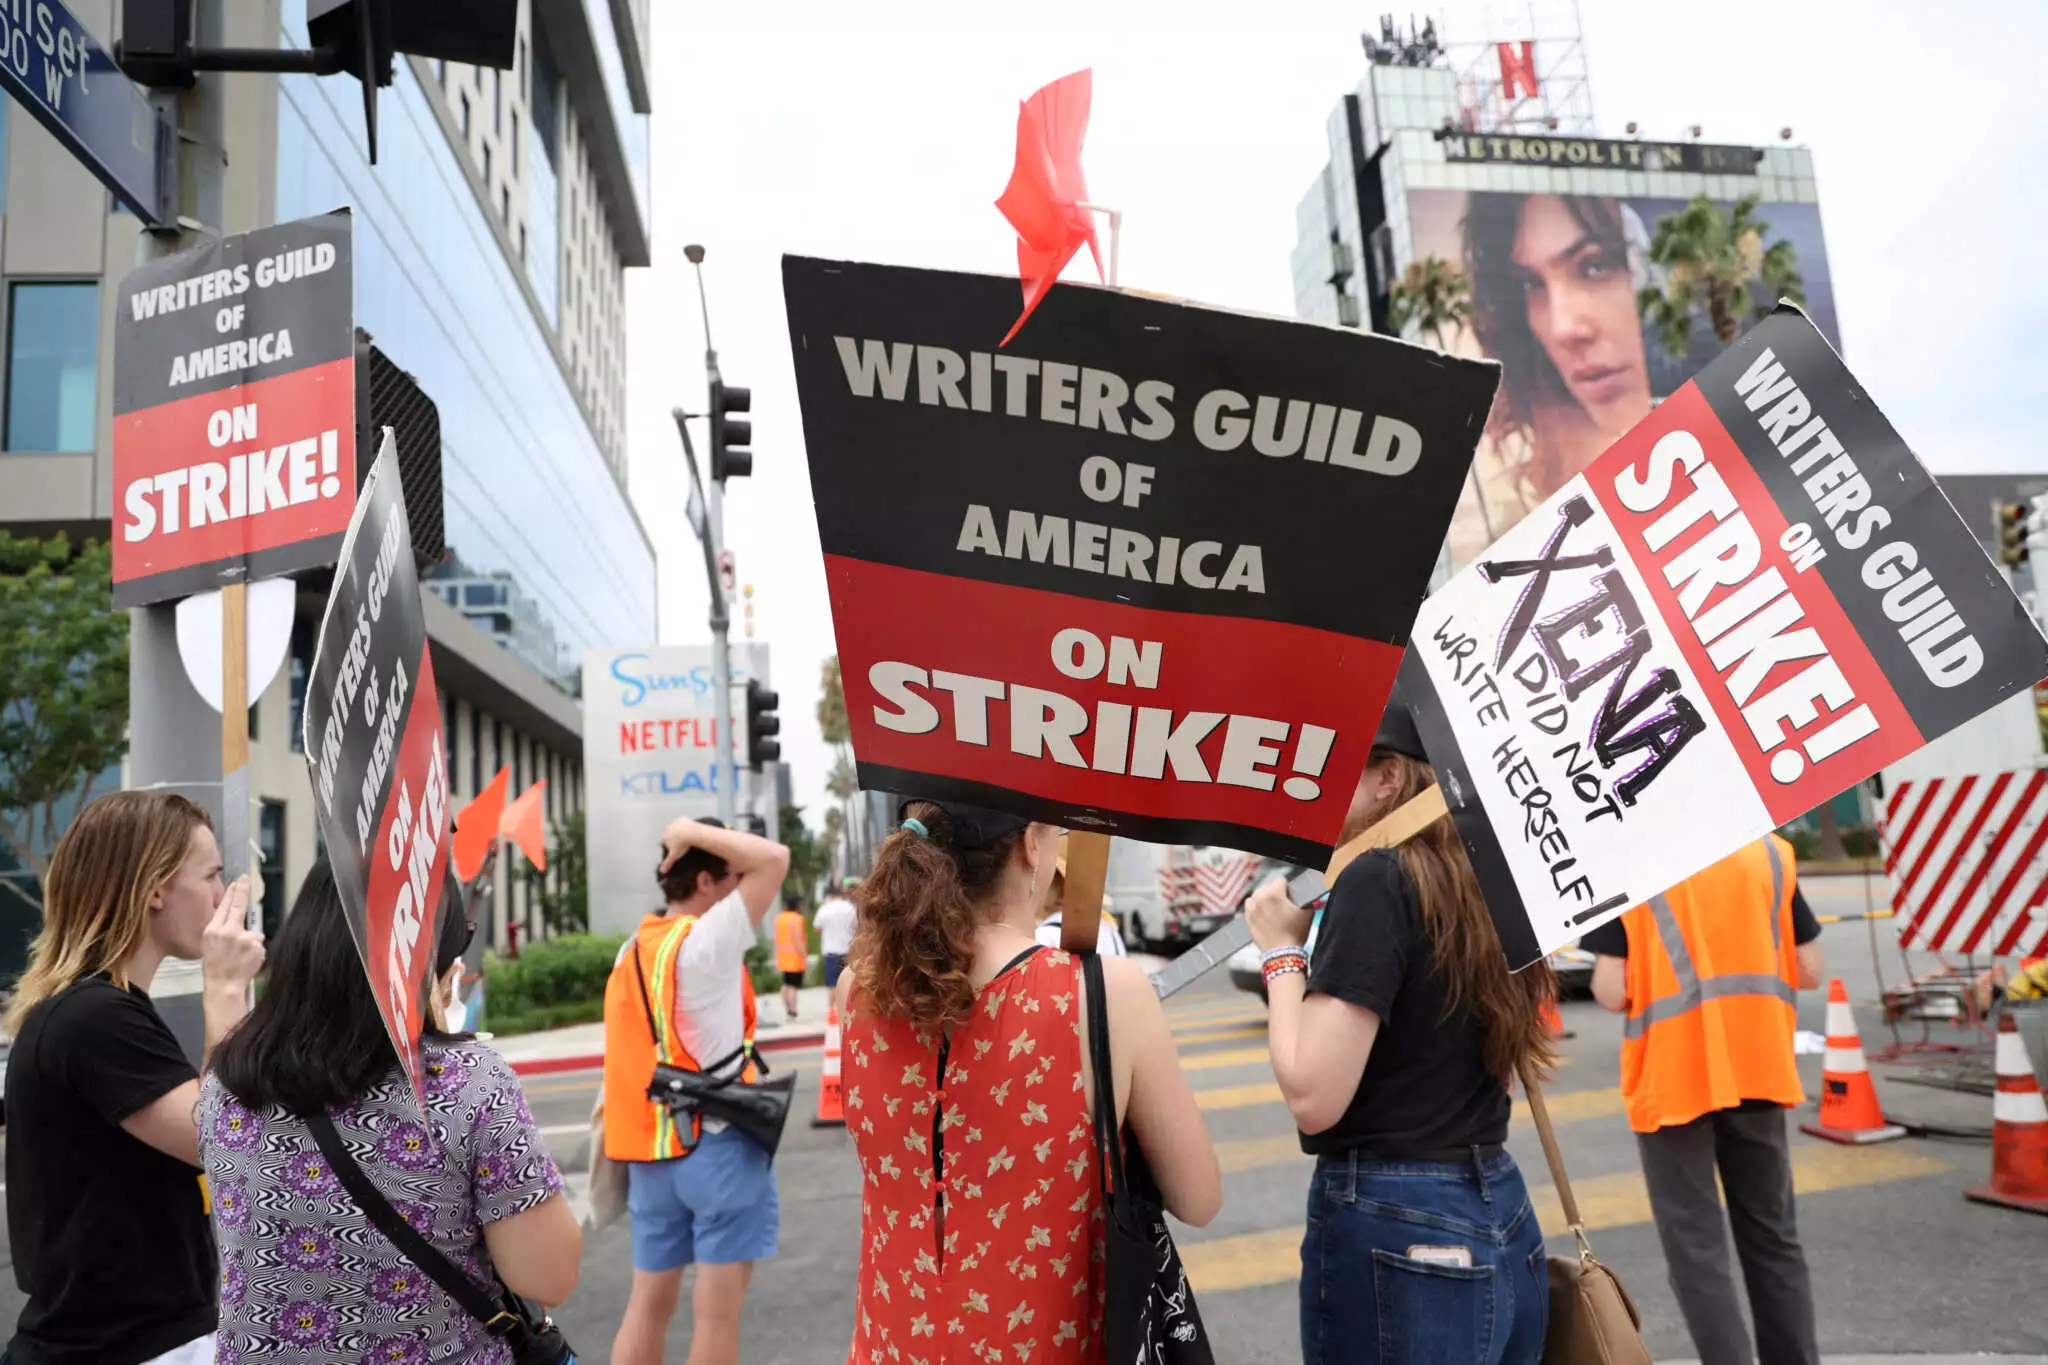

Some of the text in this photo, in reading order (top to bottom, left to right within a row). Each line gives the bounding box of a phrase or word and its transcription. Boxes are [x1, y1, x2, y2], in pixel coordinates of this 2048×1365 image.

[1497, 41, 1538, 99] N
[1443, 137, 1683, 168] METROPOLITN
[131, 243, 336, 321] WRITERS GUILD
[216, 305, 246, 334] OF
[169, 329, 294, 387] AMERICA
[208, 403, 258, 448] ON
[833, 335, 1423, 478] WRITERS GUILD
[124, 429, 341, 544] STRIKE!
[1079, 455, 1156, 509] OF
[1733, 347, 1985, 689] WRITERS GUILD
[956, 503, 1267, 595] AMERICA
[1779, 521, 1827, 574] ON
[1476, 493, 1706, 808] XENA
[1613, 429, 1880, 786] STRIKE!
[318, 501, 401, 818] WRITERS GUILD
[365, 665, 382, 728] OF
[1050, 627, 1163, 690] ON
[356, 656, 409, 858] AMERICA
[619, 716, 738, 755] NETFLI
[867, 660, 1337, 802] STRIKE!
[1434, 615, 1630, 929] WRITE HERSELF!
[1512, 653, 1623, 823] DID NOT
[389, 778, 413, 872] ON
